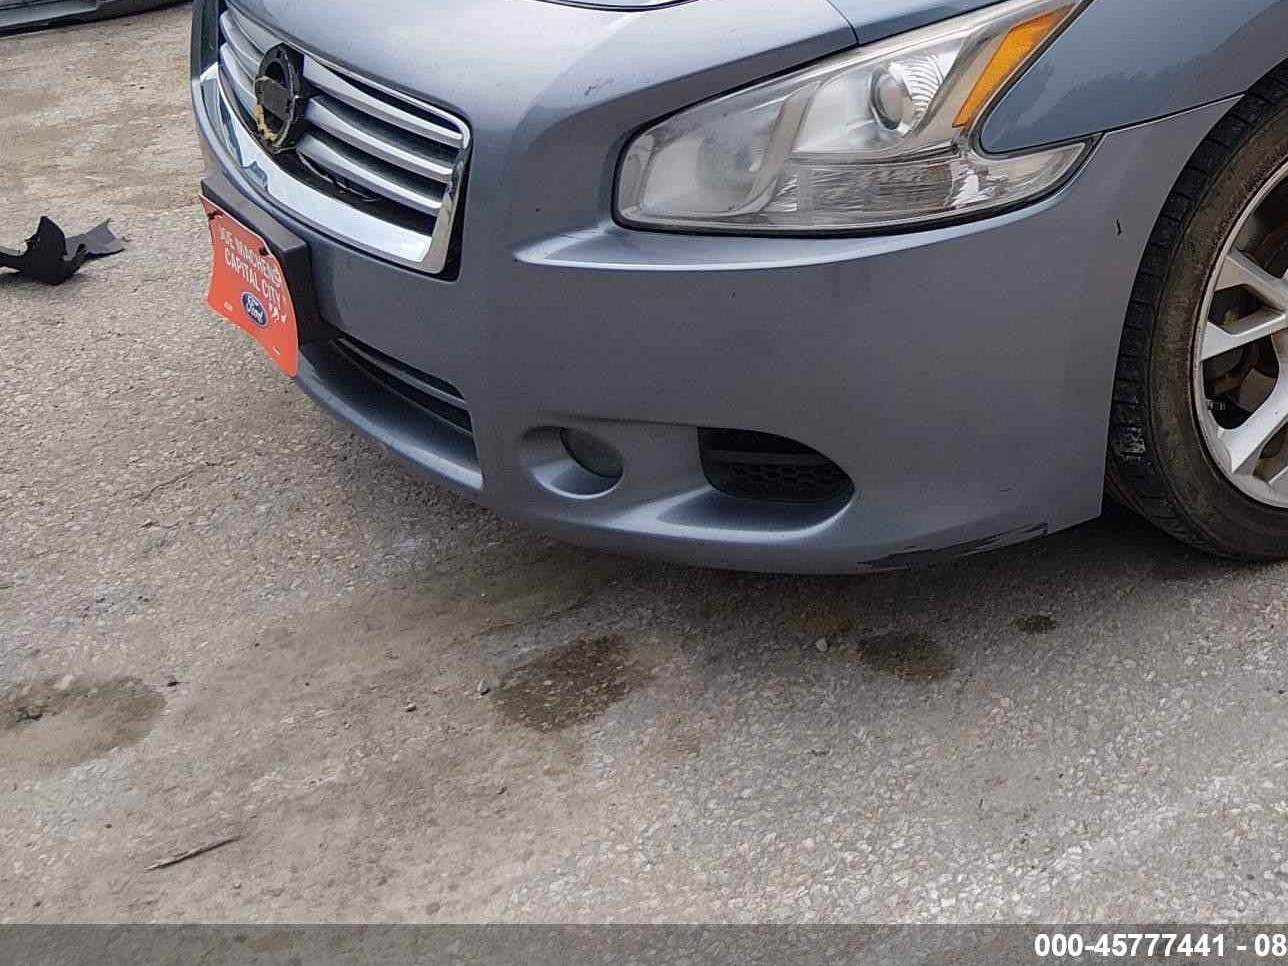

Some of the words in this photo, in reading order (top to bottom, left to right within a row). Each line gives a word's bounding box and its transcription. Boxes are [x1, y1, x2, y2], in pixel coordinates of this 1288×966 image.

[224, 247, 261, 292] CAPITAL
[261, 278, 282, 310] CITY
[246, 294, 263, 324] Ford
